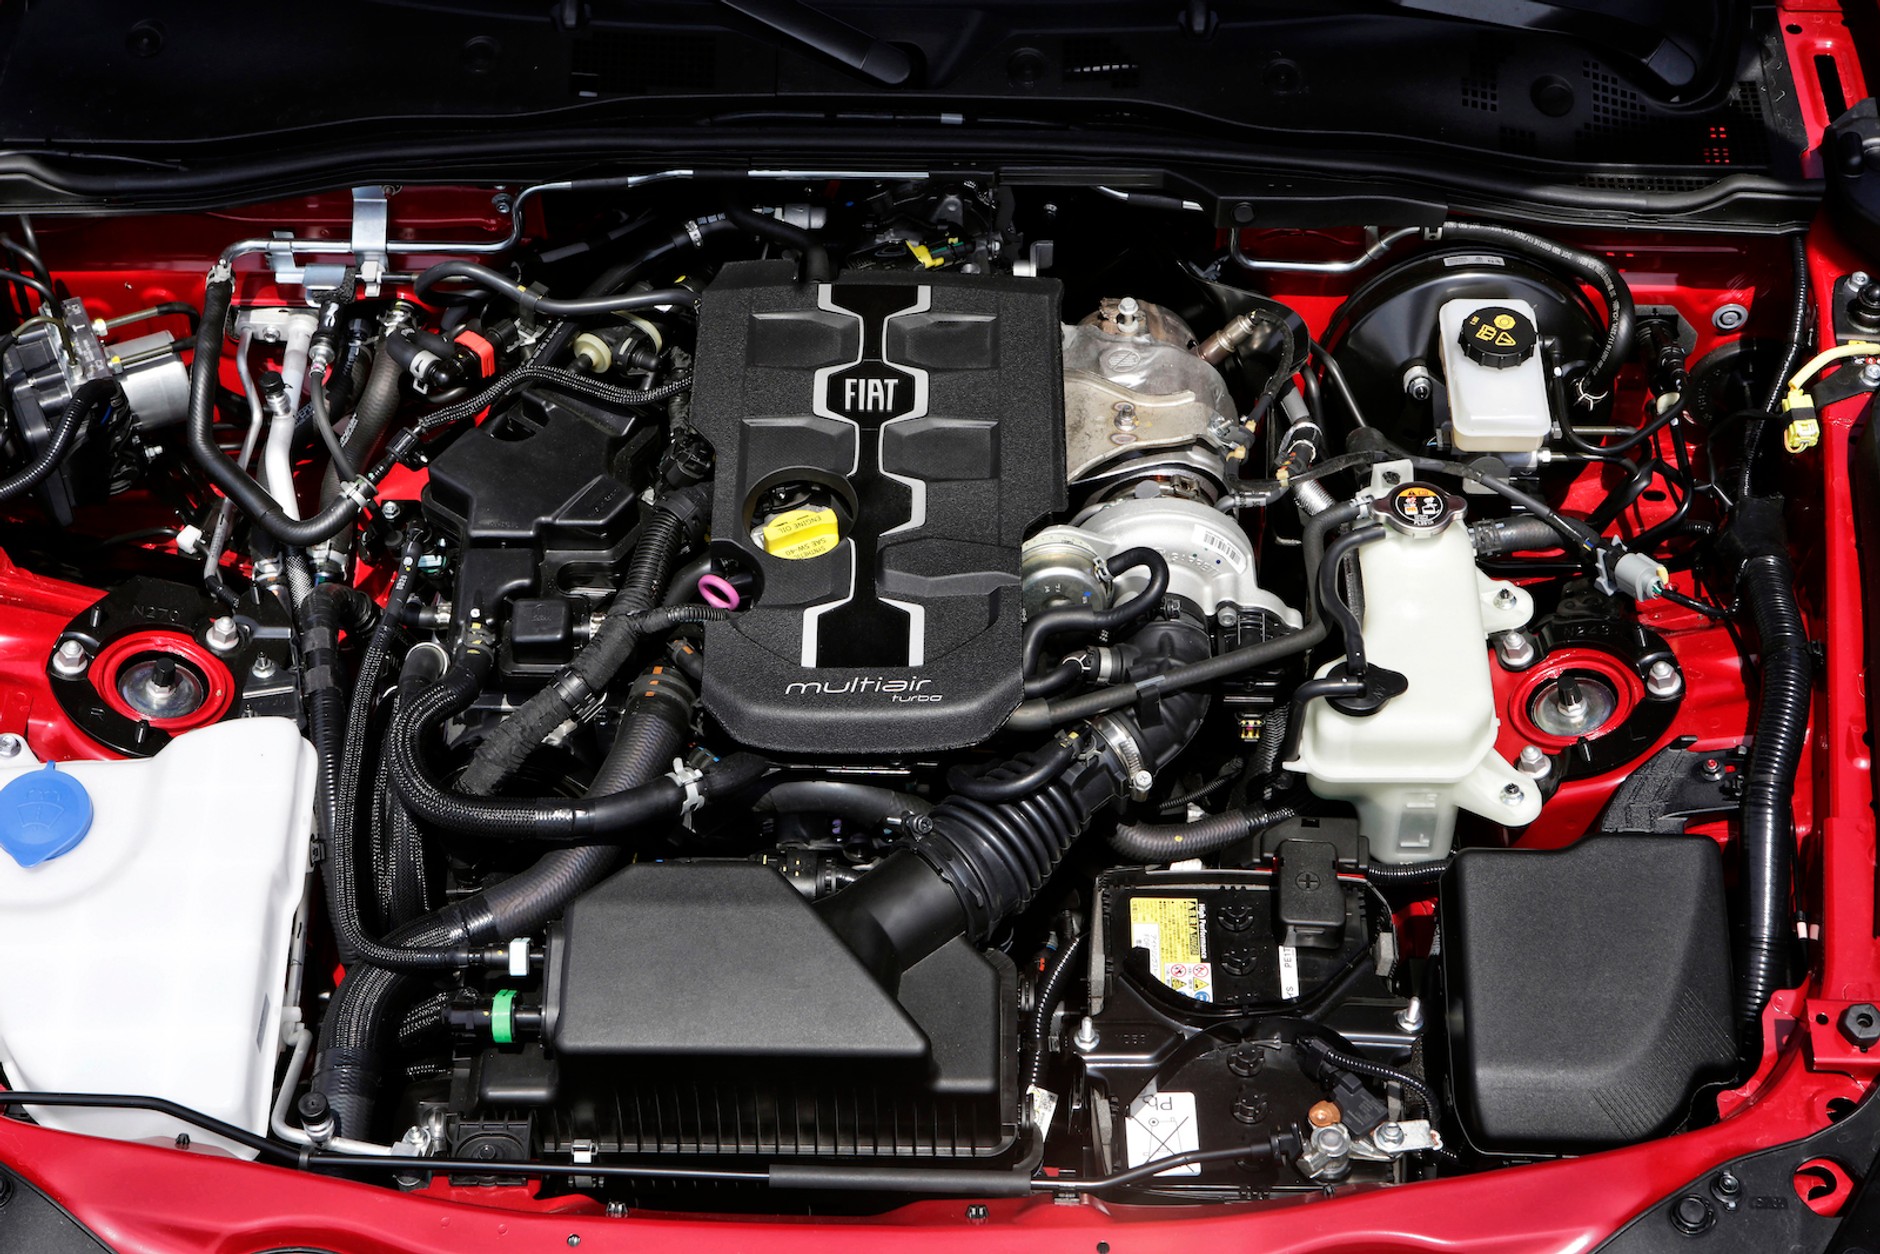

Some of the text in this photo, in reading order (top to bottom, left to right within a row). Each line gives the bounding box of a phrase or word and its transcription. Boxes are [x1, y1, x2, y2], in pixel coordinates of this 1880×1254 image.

[845, 378, 899, 412] FIAT
[778, 515, 822, 534] ENGINE OIL
[785, 537, 827, 556] SAE 5W-40
[785, 676, 932, 695] multiair
[891, 694, 943, 702] turbo
[1198, 903, 1208, 960] High Performance
[1142, 1094, 1173, 1111] Pb
